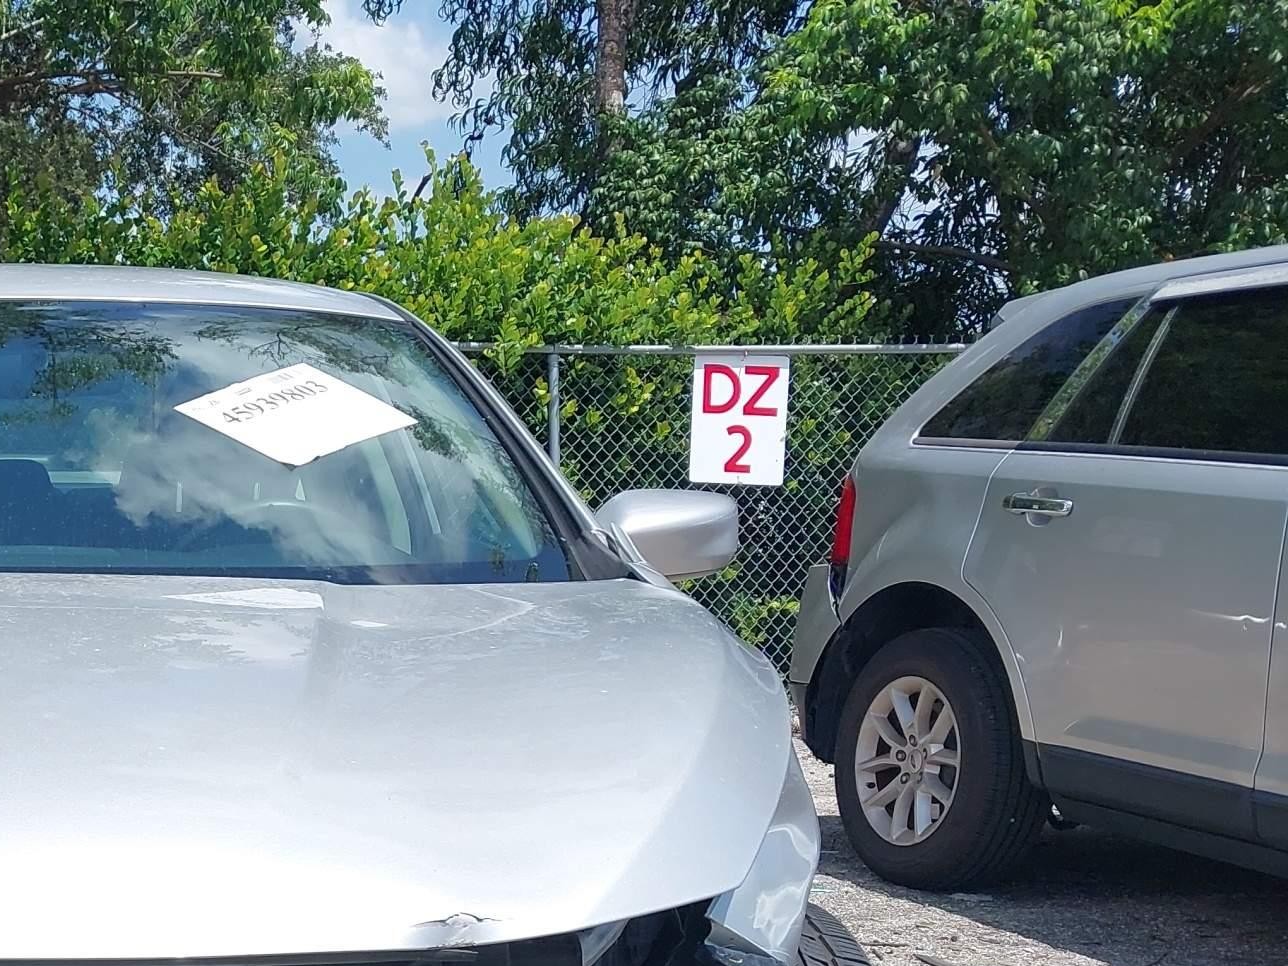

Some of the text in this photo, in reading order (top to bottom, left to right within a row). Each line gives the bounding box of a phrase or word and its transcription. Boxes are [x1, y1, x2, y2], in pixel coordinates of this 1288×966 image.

[222, 380, 329, 424] 45939803
[703, 364, 780, 416] DZ
[724, 425, 752, 473] 2
